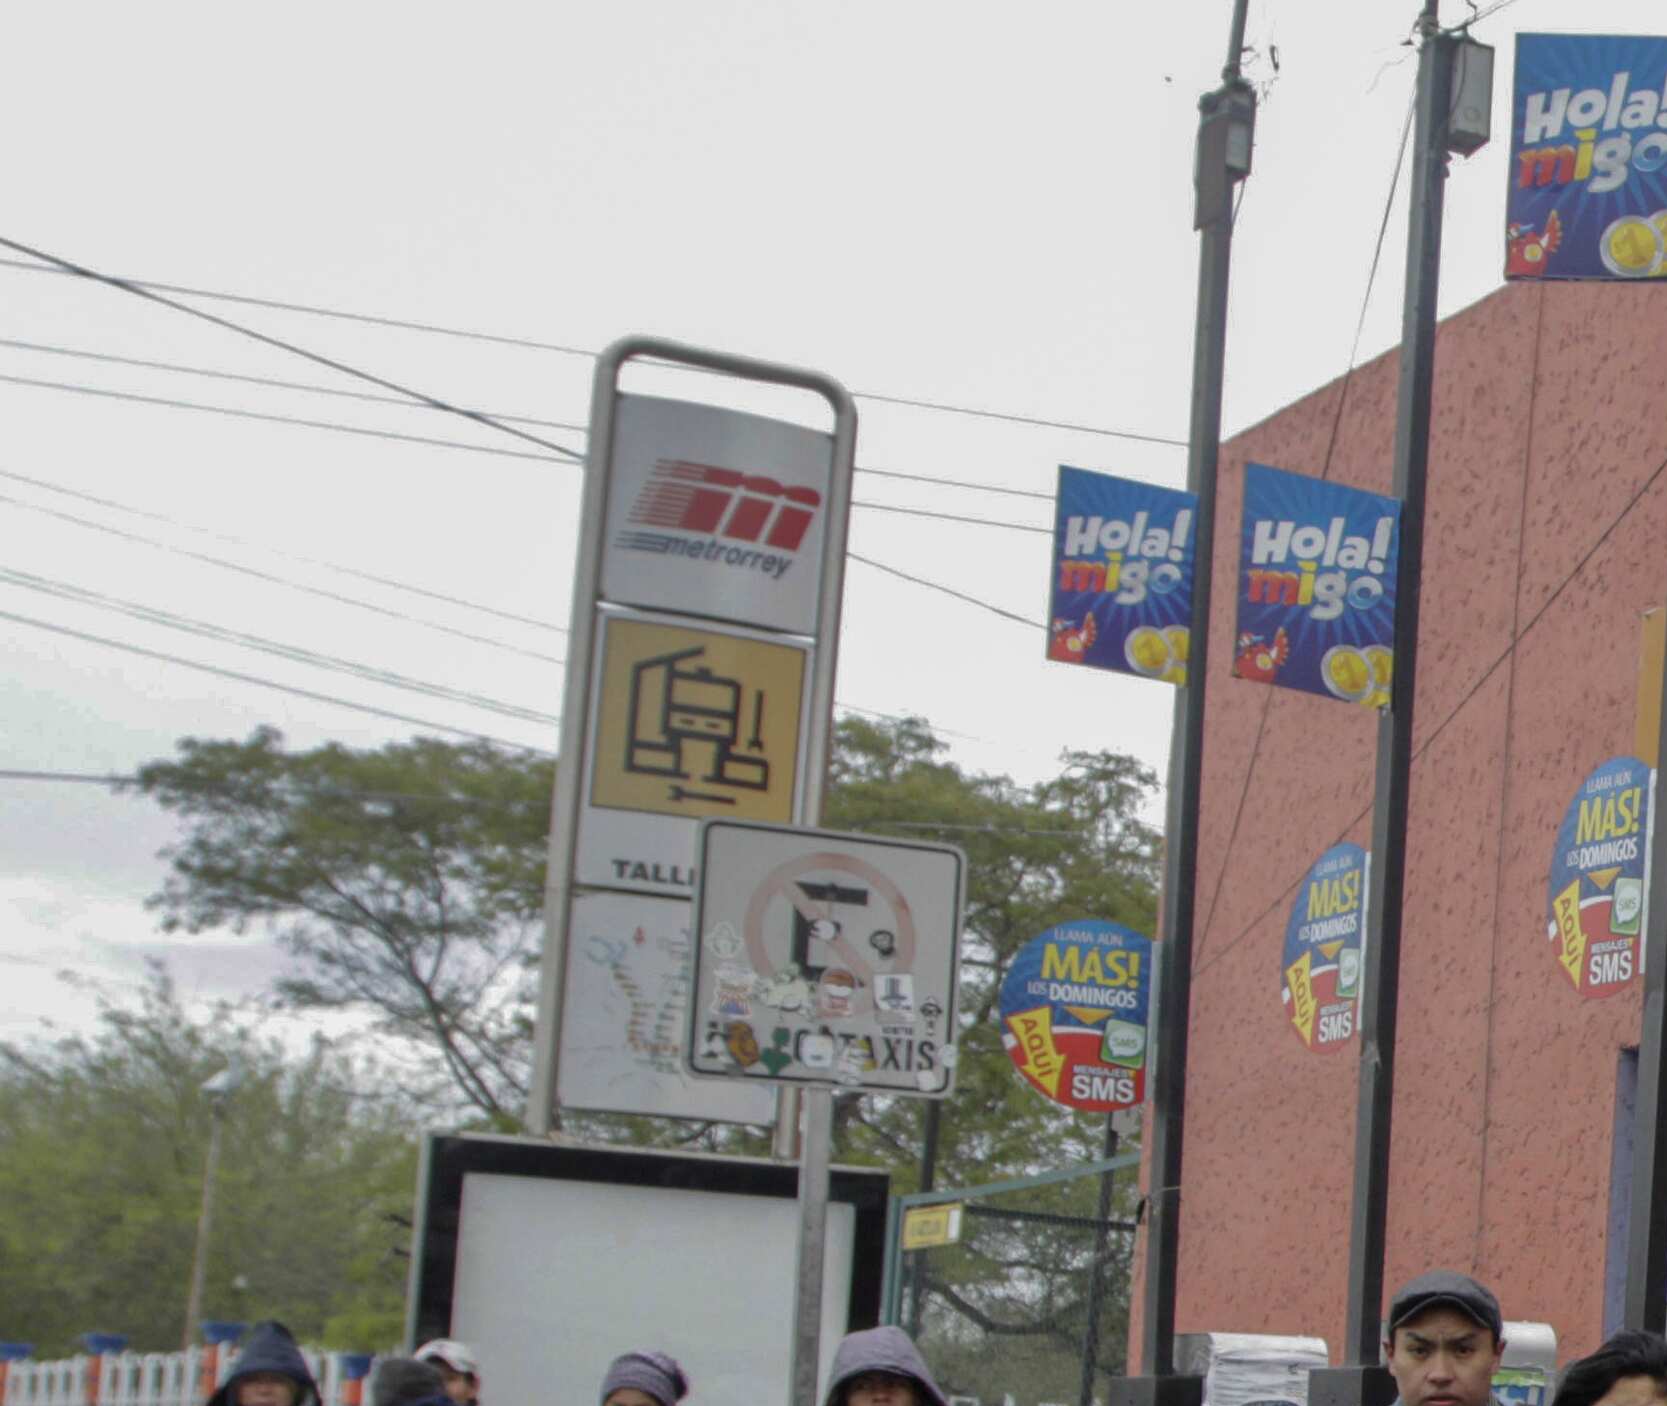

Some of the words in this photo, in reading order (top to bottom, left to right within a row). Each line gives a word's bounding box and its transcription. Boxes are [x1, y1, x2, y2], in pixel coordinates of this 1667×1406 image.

[650, 528, 793, 580] metrorrey
[1064, 509, 1192, 563] Hola!
[1252, 516, 1395, 575] Hola!
[1060, 552, 1182, 606] migo
[1248, 561, 1384, 621] migo
[1579, 838, 1638, 869] DOMINGOS
[1041, 944, 1140, 988] MÁS!
[1589, 951, 1633, 985] SMS
[1050, 983, 1138, 1009] DOMINGOS
[1319, 1013, 1352, 1043] SMS
[1072, 1075, 1136, 1103] SMS
